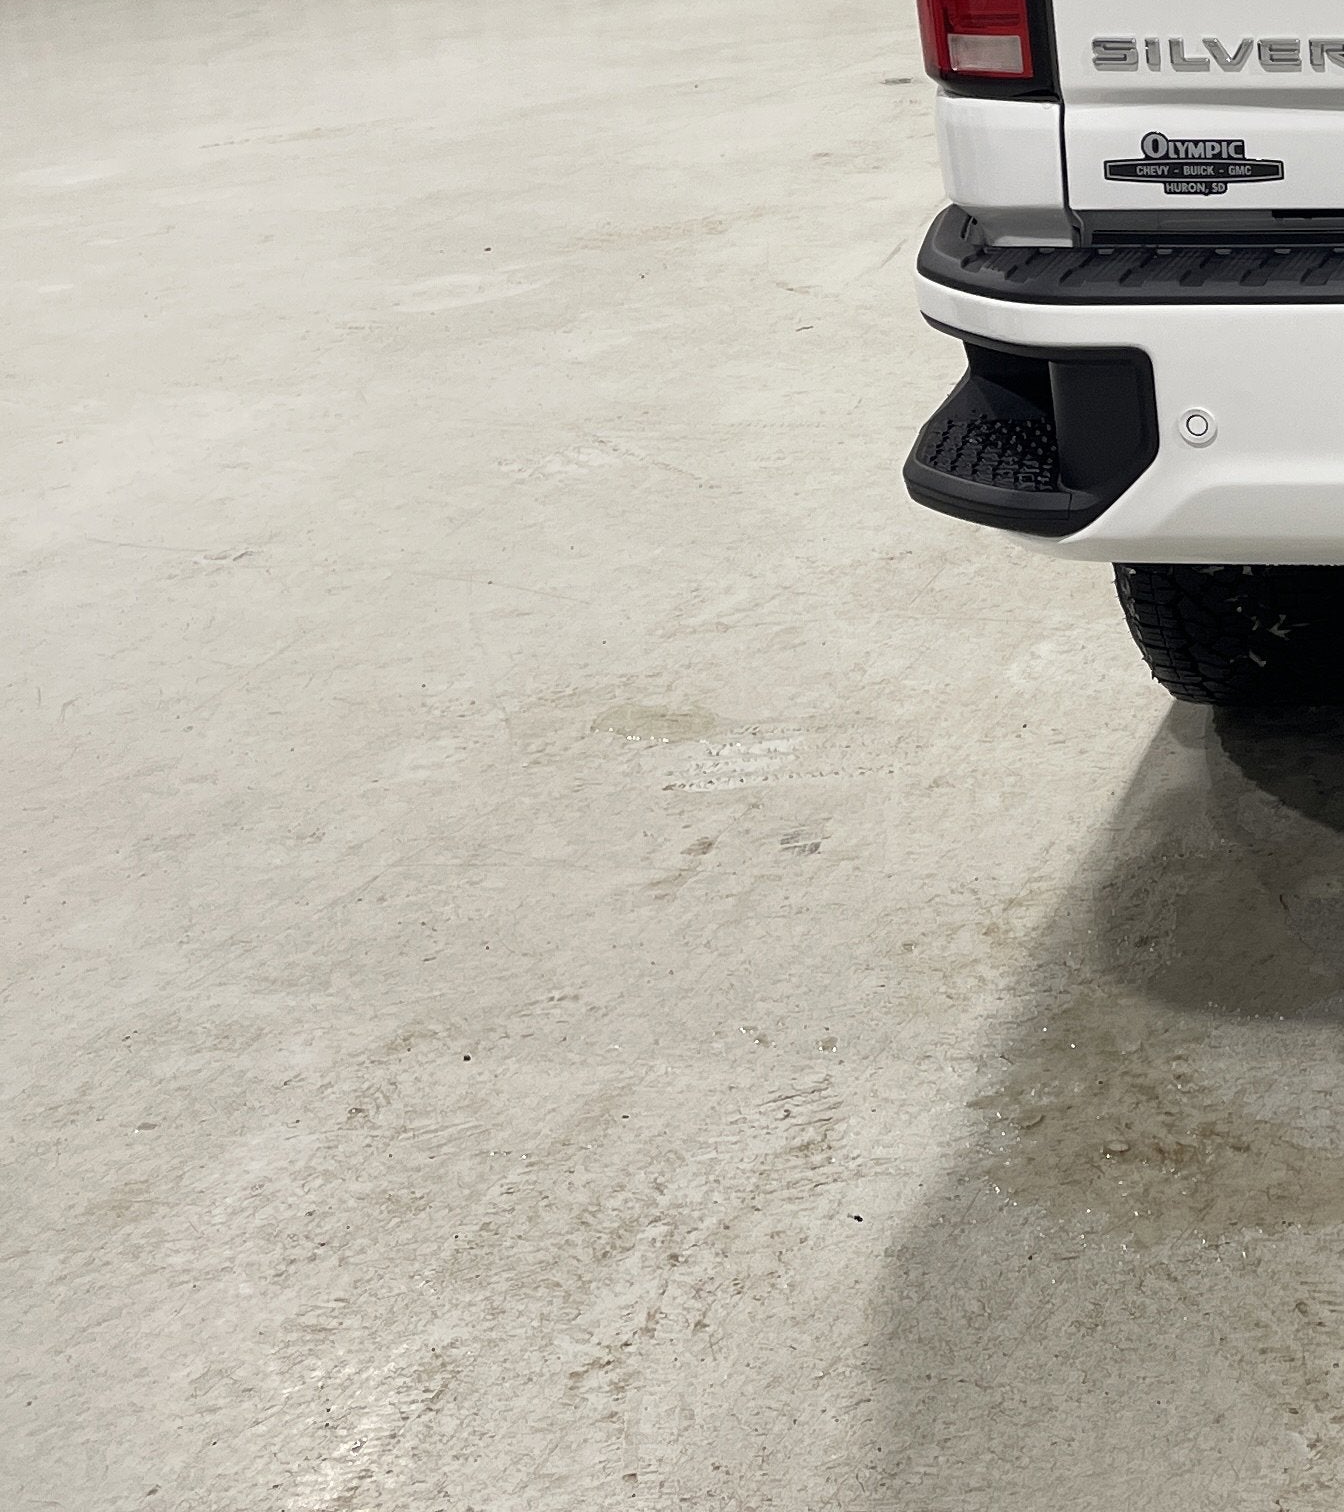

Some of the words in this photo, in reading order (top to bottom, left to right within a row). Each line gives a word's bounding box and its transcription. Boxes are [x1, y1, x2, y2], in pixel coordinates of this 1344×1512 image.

[1136, 165, 1169, 176] CHEVY
[1183, 165, 1214, 176] BUICK
[1228, 165, 1252, 176] GMC
[1166, 182, 1208, 193] HURON,
[1212, 182, 1226, 192] SD
